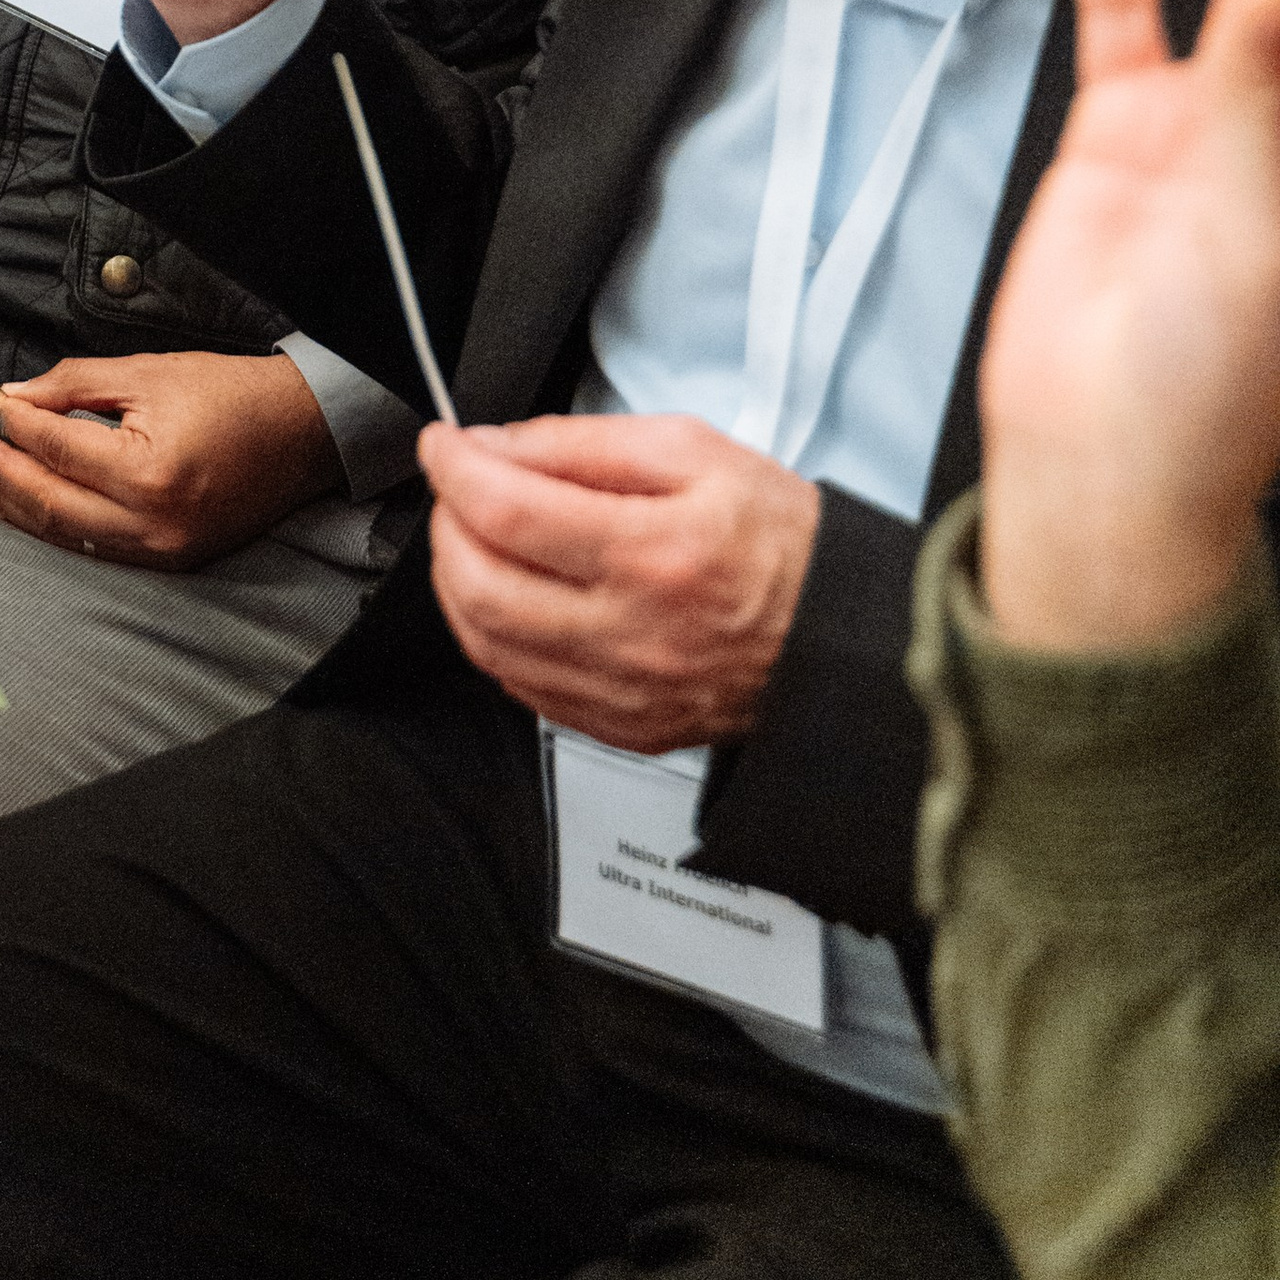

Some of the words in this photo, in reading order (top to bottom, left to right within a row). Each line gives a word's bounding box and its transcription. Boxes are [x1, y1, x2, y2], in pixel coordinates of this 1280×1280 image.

[617, 838, 667, 869] Heinz
[598, 862, 643, 891] Ultra
[648, 878, 773, 936] International
